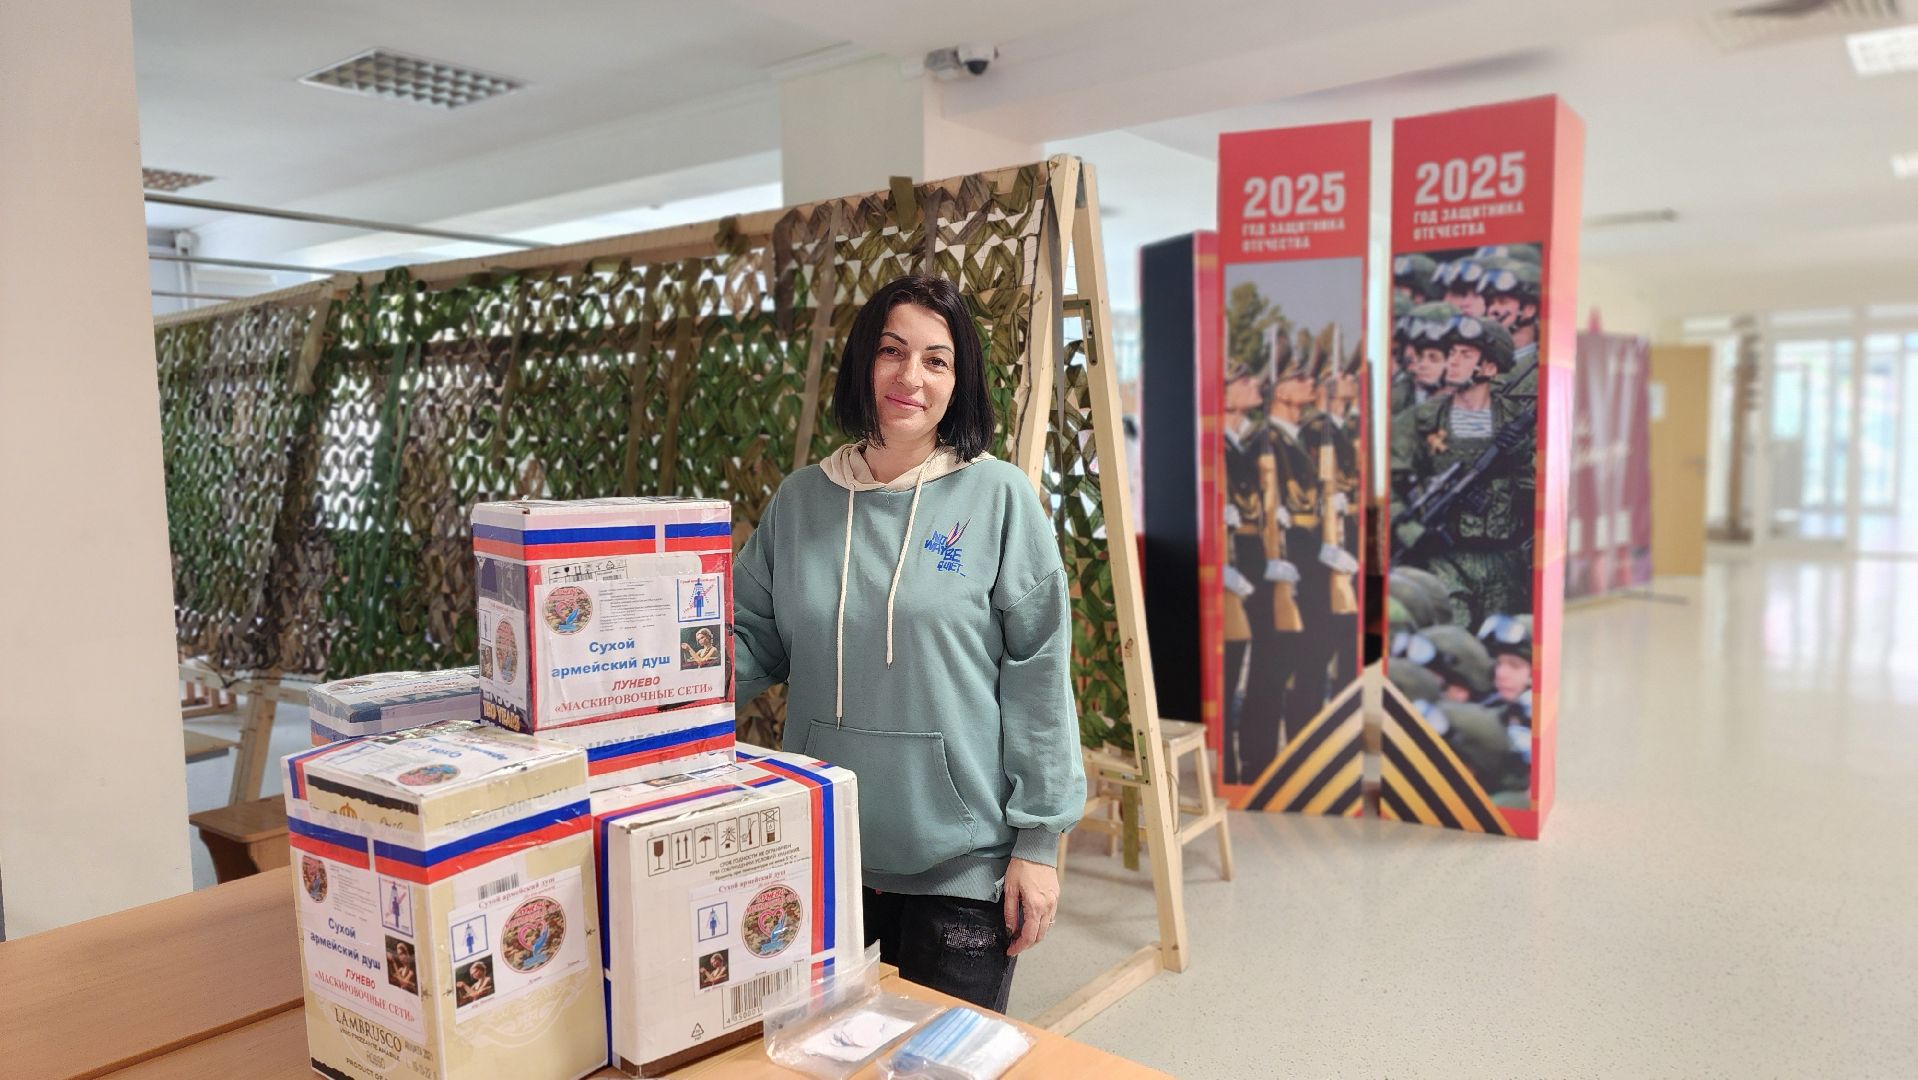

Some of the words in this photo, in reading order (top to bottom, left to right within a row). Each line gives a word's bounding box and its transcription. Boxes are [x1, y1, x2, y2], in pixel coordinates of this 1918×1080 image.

[1415, 151, 1526, 205] 2025
[1242, 171, 1345, 218] 2025
[1413, 209, 1438, 224] ГОД
[1441, 201, 1524, 222] ЗАЩИТНИКА
[1242, 222, 1265, 236] ГОД
[1268, 217, 1345, 236] ЗАЩИТНИКА
[1413, 222, 1485, 240] ОТЕЧЕСТВА
[1241, 236, 1311, 252] ОТЕЧЕСТВА
[588, 638, 635, 655] Сухой
[551, 656, 637, 679] армейский
[641, 655, 671, 670] душ
[611, 676, 661, 691] ЛУНЕВО
[554, 688, 675, 713] «МАСКИРОВОЧНЫЕ
[677, 683, 713, 696] СЕТИ»
[328, 917, 356, 940] Сухой
[310, 931, 360, 961] армейский
[361, 954, 381, 970] душ
[345, 969, 376, 990] ЛУНЕВО
[314, 970, 388, 1012] «МАСКИРОВОЧНЫЕ
[388, 1004, 415, 1023] СЕТИ»
[334, 1007, 402, 1052] LAMBRUSCO
[346, 1057, 374, 1076] PRODUCT
